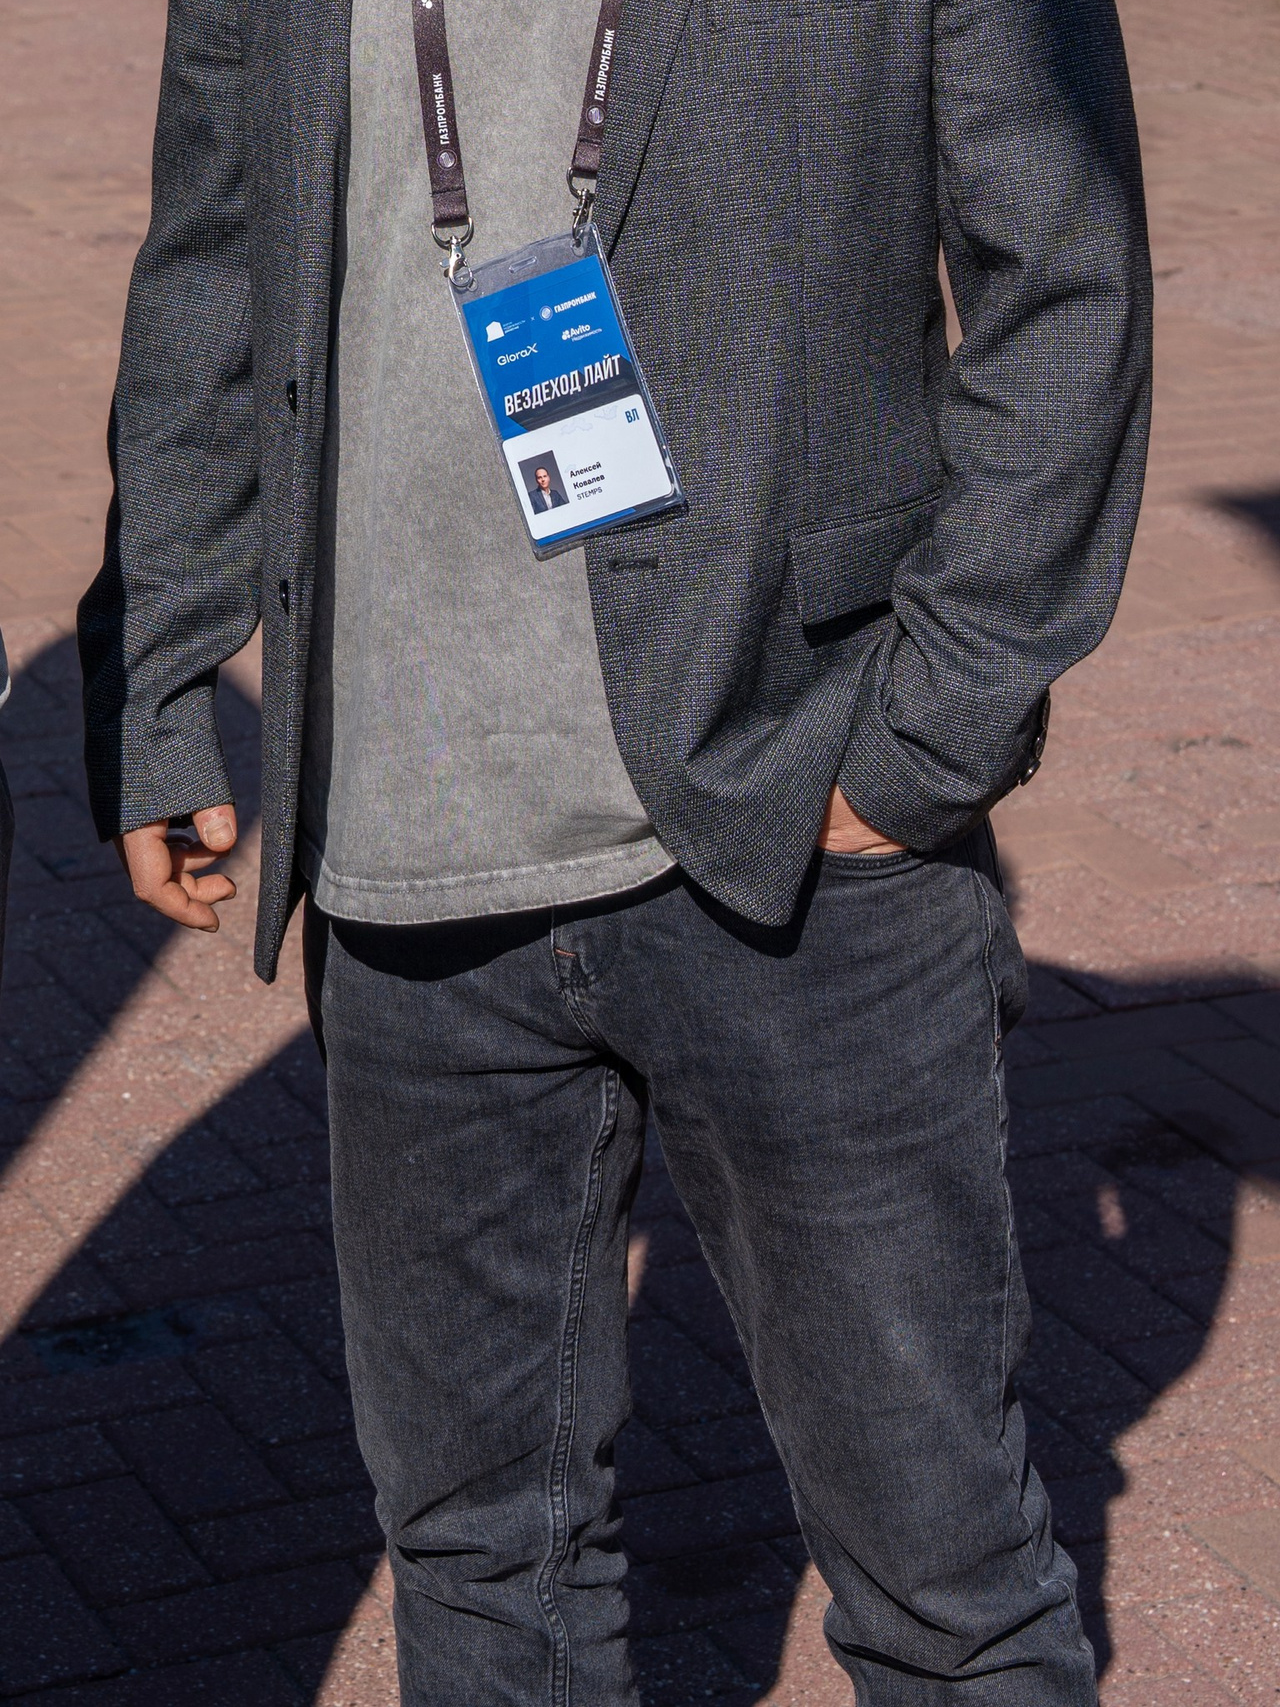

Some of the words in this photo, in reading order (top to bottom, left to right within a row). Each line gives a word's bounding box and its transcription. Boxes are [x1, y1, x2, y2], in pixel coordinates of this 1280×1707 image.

[594, 28, 615, 101] ГАЗПРОМБАНК
[432, 73, 450, 145] ГАЗПРОМБАНК
[554, 291, 597, 314] ГАЗПРОМБАНК
[570, 324, 591, 338] Avito
[497, 342, 538, 366] GloraX
[504, 370, 582, 416] ВЕЗДЕХОД
[584, 354, 621, 388] ЛАЙТ
[625, 408, 640, 424] ВЛ
[569, 461, 602, 478] Алексей
[573, 473, 606, 490] Ковалев
[577, 486, 603, 501] STEMPS
